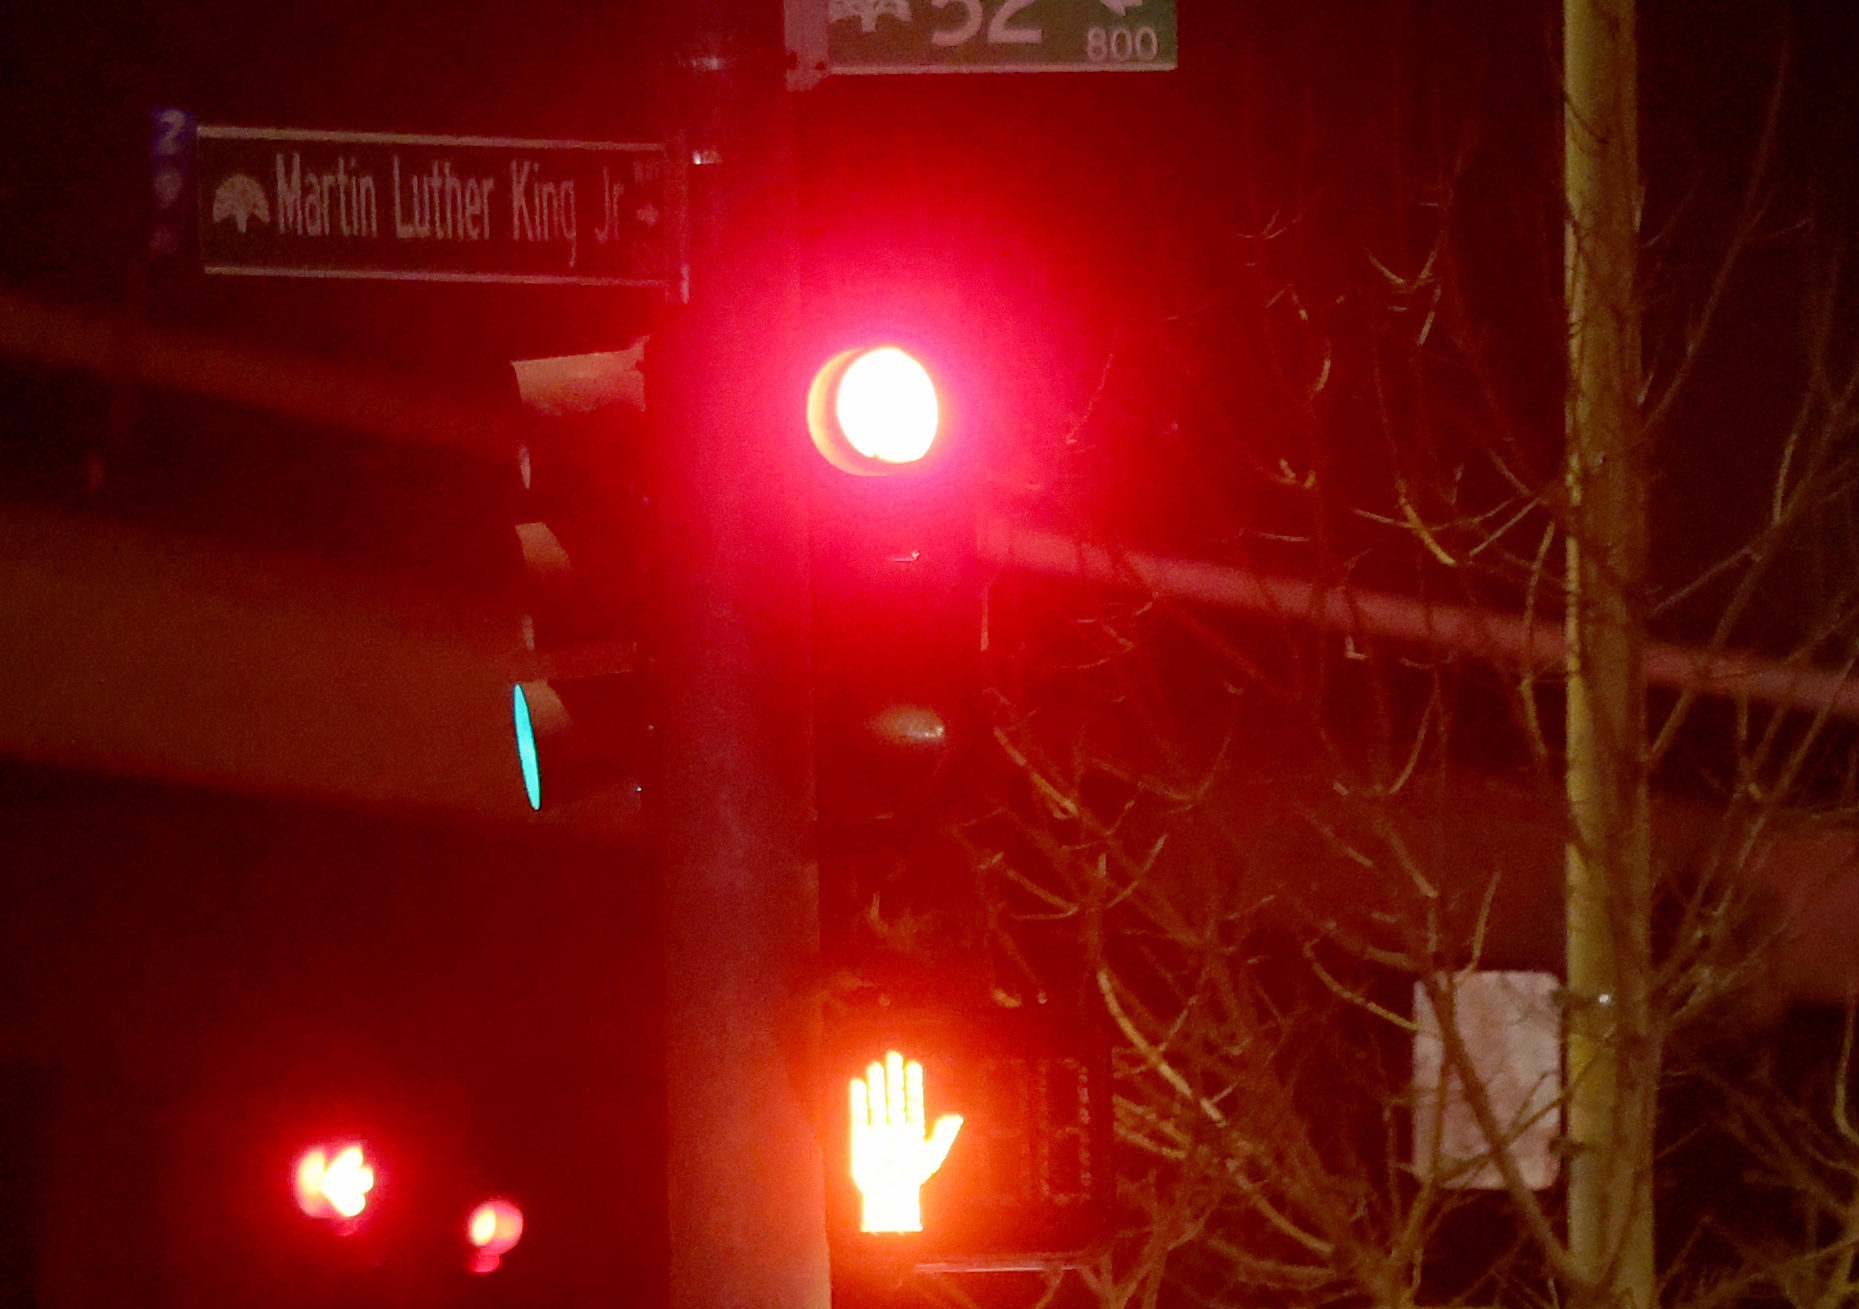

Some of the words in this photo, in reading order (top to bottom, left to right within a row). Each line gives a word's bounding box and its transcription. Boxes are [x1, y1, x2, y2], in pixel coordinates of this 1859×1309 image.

[1086, 26, 1160, 61] 800
[274, 151, 379, 238] Martin
[393, 154, 495, 242] Luther
[509, 159, 579, 269] King
[593, 165, 625, 247] Jr
